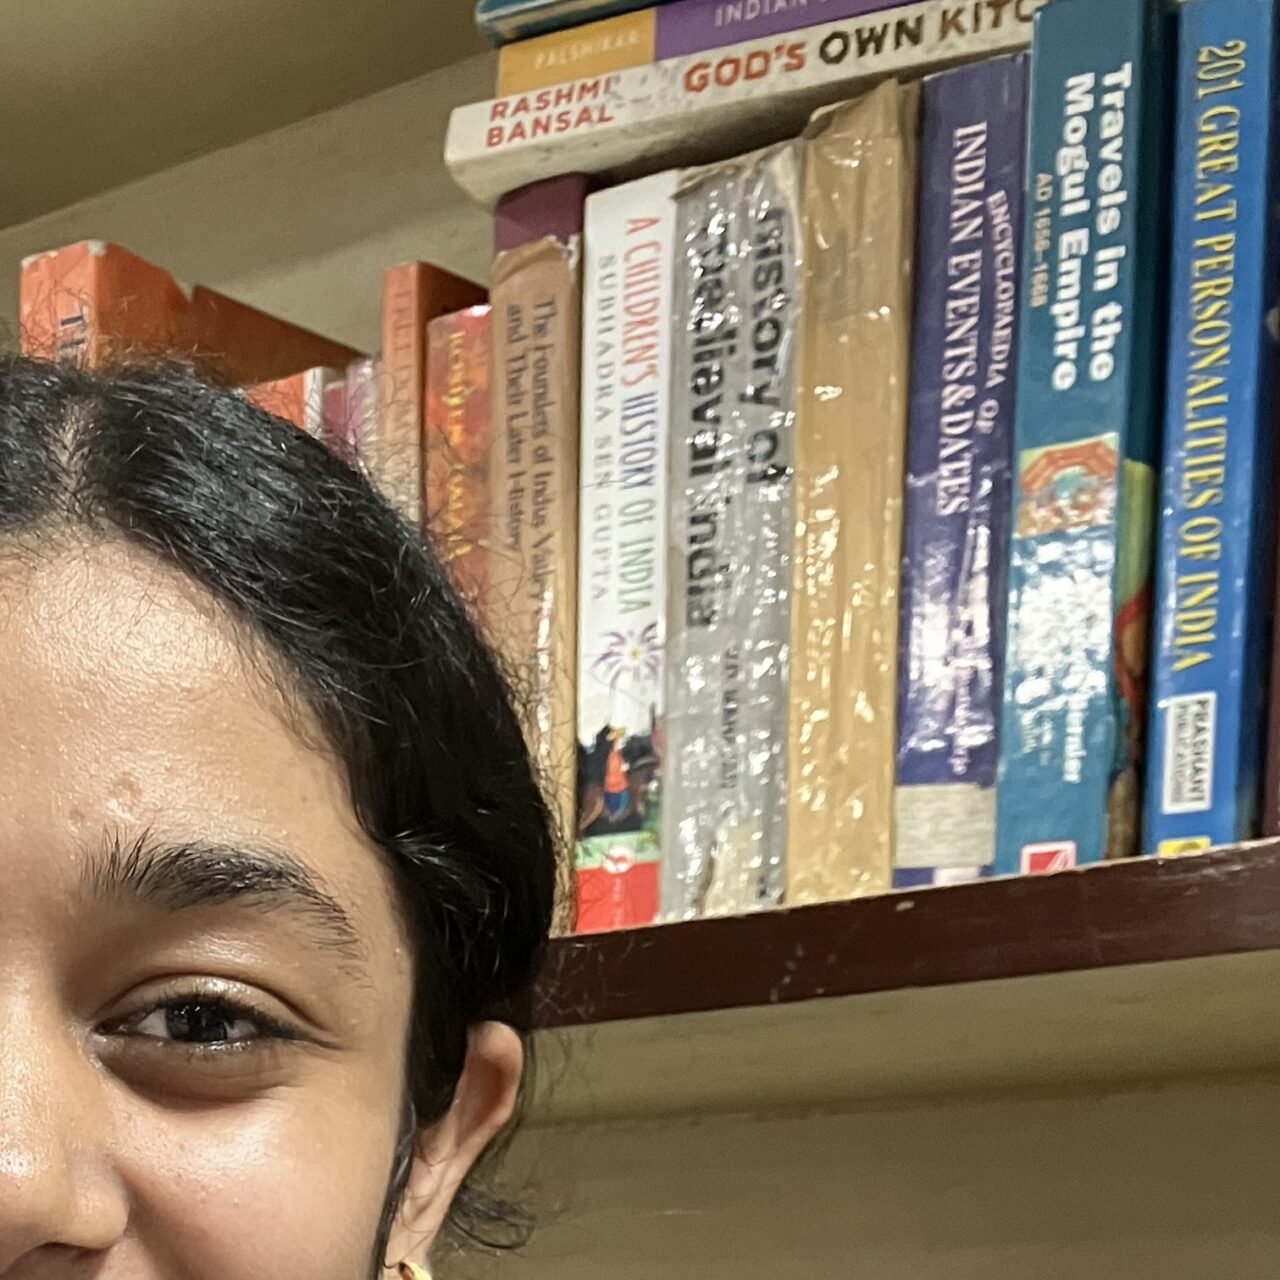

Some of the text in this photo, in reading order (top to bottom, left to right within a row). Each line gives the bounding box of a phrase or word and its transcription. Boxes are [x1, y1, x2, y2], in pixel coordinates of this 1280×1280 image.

[534, 29, 640, 70] PALSHIKAR
[683, 43, 807, 94] GOD'S
[819, 14, 926, 66] OWN
[486, 103, 615, 148] BANSAL
[490, 76, 614, 122] RASHMI
[950, 120, 988, 243] INDIAN
[1035, 173, 1053, 202] AD
[1097, 62, 1132, 235] Travels
[1050, 72, 1095, 390] Mogul Empire
[534, 293, 556, 336] The
[974, 189, 1015, 433] ENCYCLOPAEDIA OF
[1089, 301, 1122, 381] the
[531, 344, 555, 439] Founders
[1170, 38, 1247, 672] 201 GREAT PERSONALITIES OF INDIA
[505, 303, 528, 553] and Their Later History
[533, 445, 553, 464] of
[590, 254, 618, 601] SUBHADRA SEN GUPTA
[617, 216, 662, 615] A CHILDREN'S HISTORY OF INDIA
[531, 472, 555, 528] Indus
[530, 532, 555, 602] Valley
